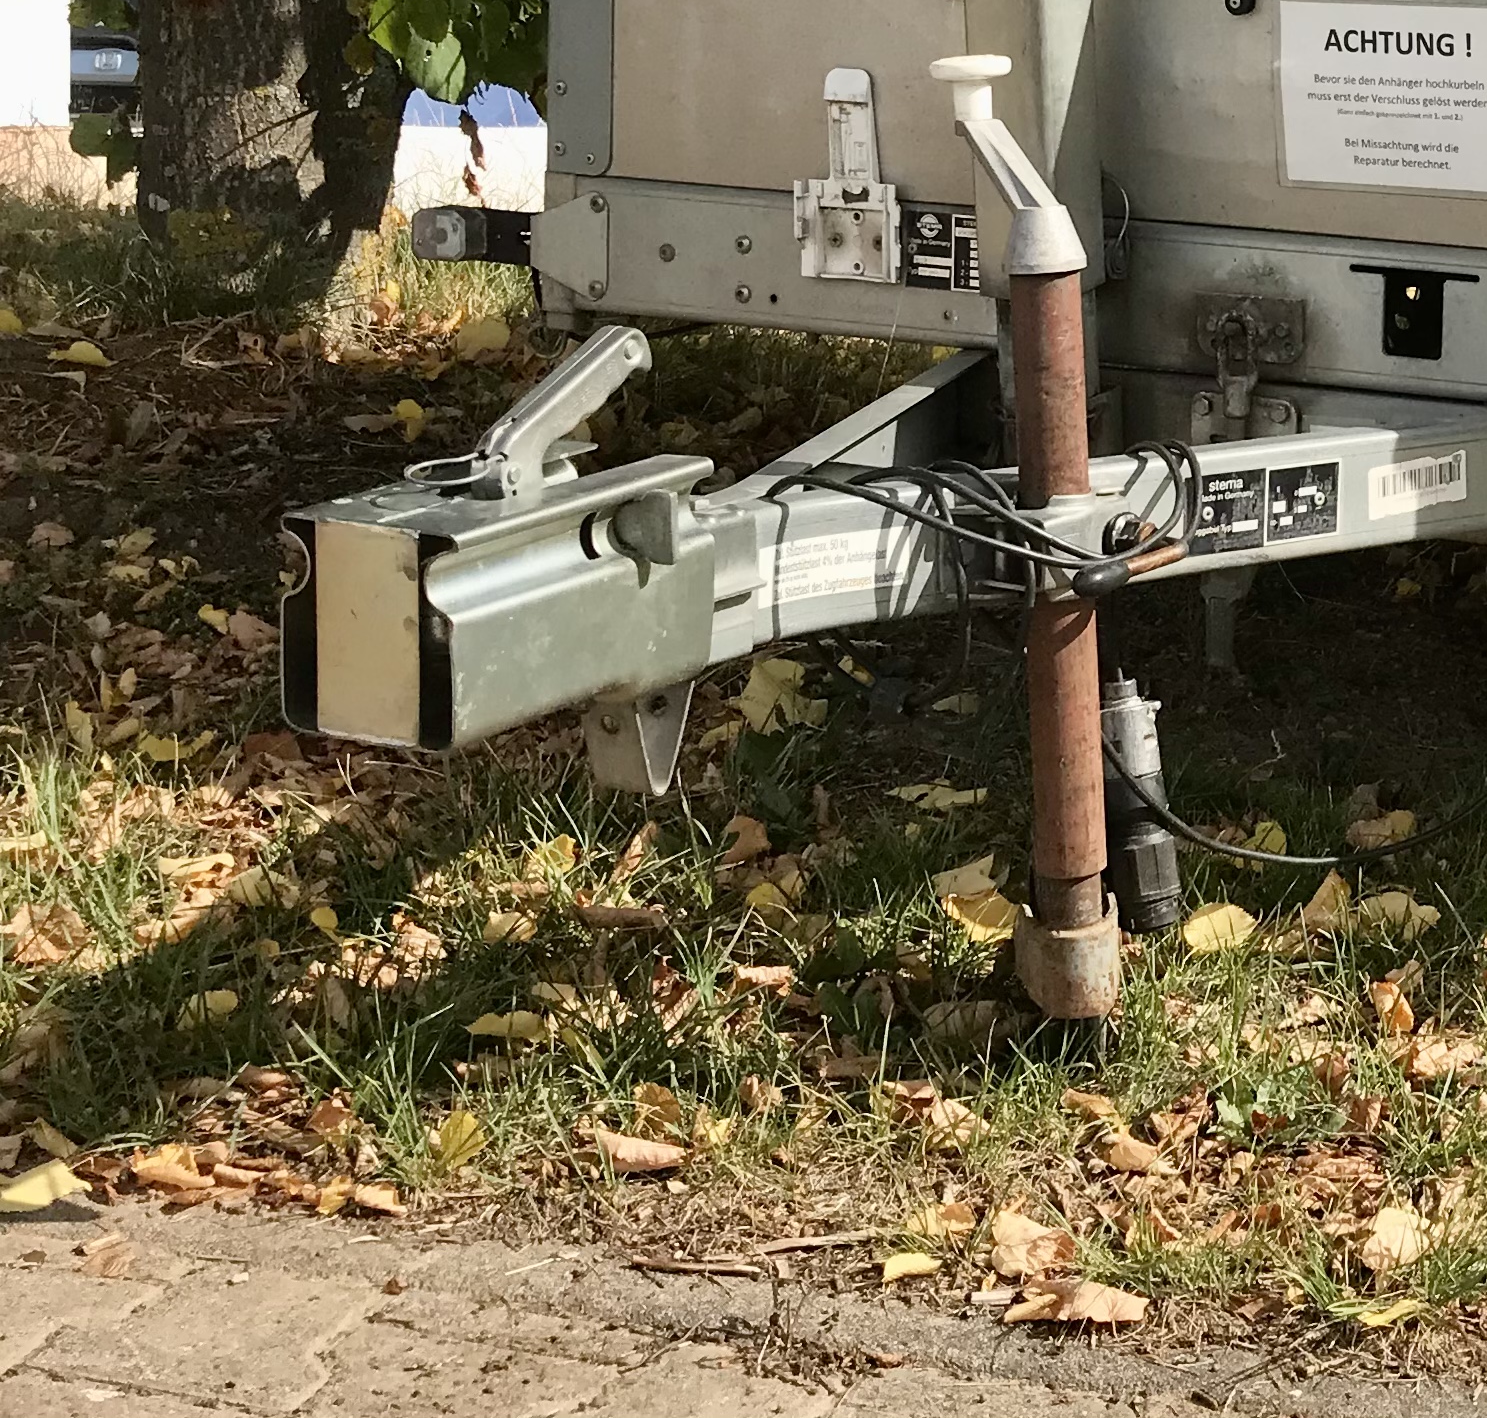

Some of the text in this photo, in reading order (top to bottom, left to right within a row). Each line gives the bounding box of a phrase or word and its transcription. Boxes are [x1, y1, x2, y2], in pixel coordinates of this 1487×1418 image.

[1324, 29, 1472, 58] ACHTUNG !
[1314, 74, 1485, 91] Bevor sie den Anhänger hochkurbeln
[1308, 92, 1332, 101] muss
[1333, 93, 1352, 102] erst
[1353, 93, 1369, 103] der
[1371, 94, 1420, 106] Verschluss
[1422, 96, 1451, 108] gelöst
[1344, 137, 1459, 153] Bei Missachtung wird die
[1354, 155, 1452, 170] Reparatur berechnet.
[1208, 478, 1244, 492] stema
[1217, 493, 1224, 501] in
[1224, 490, 1255, 500] Germany
[829, 539, 838, 550] 50
[840, 538, 849, 551] kg
